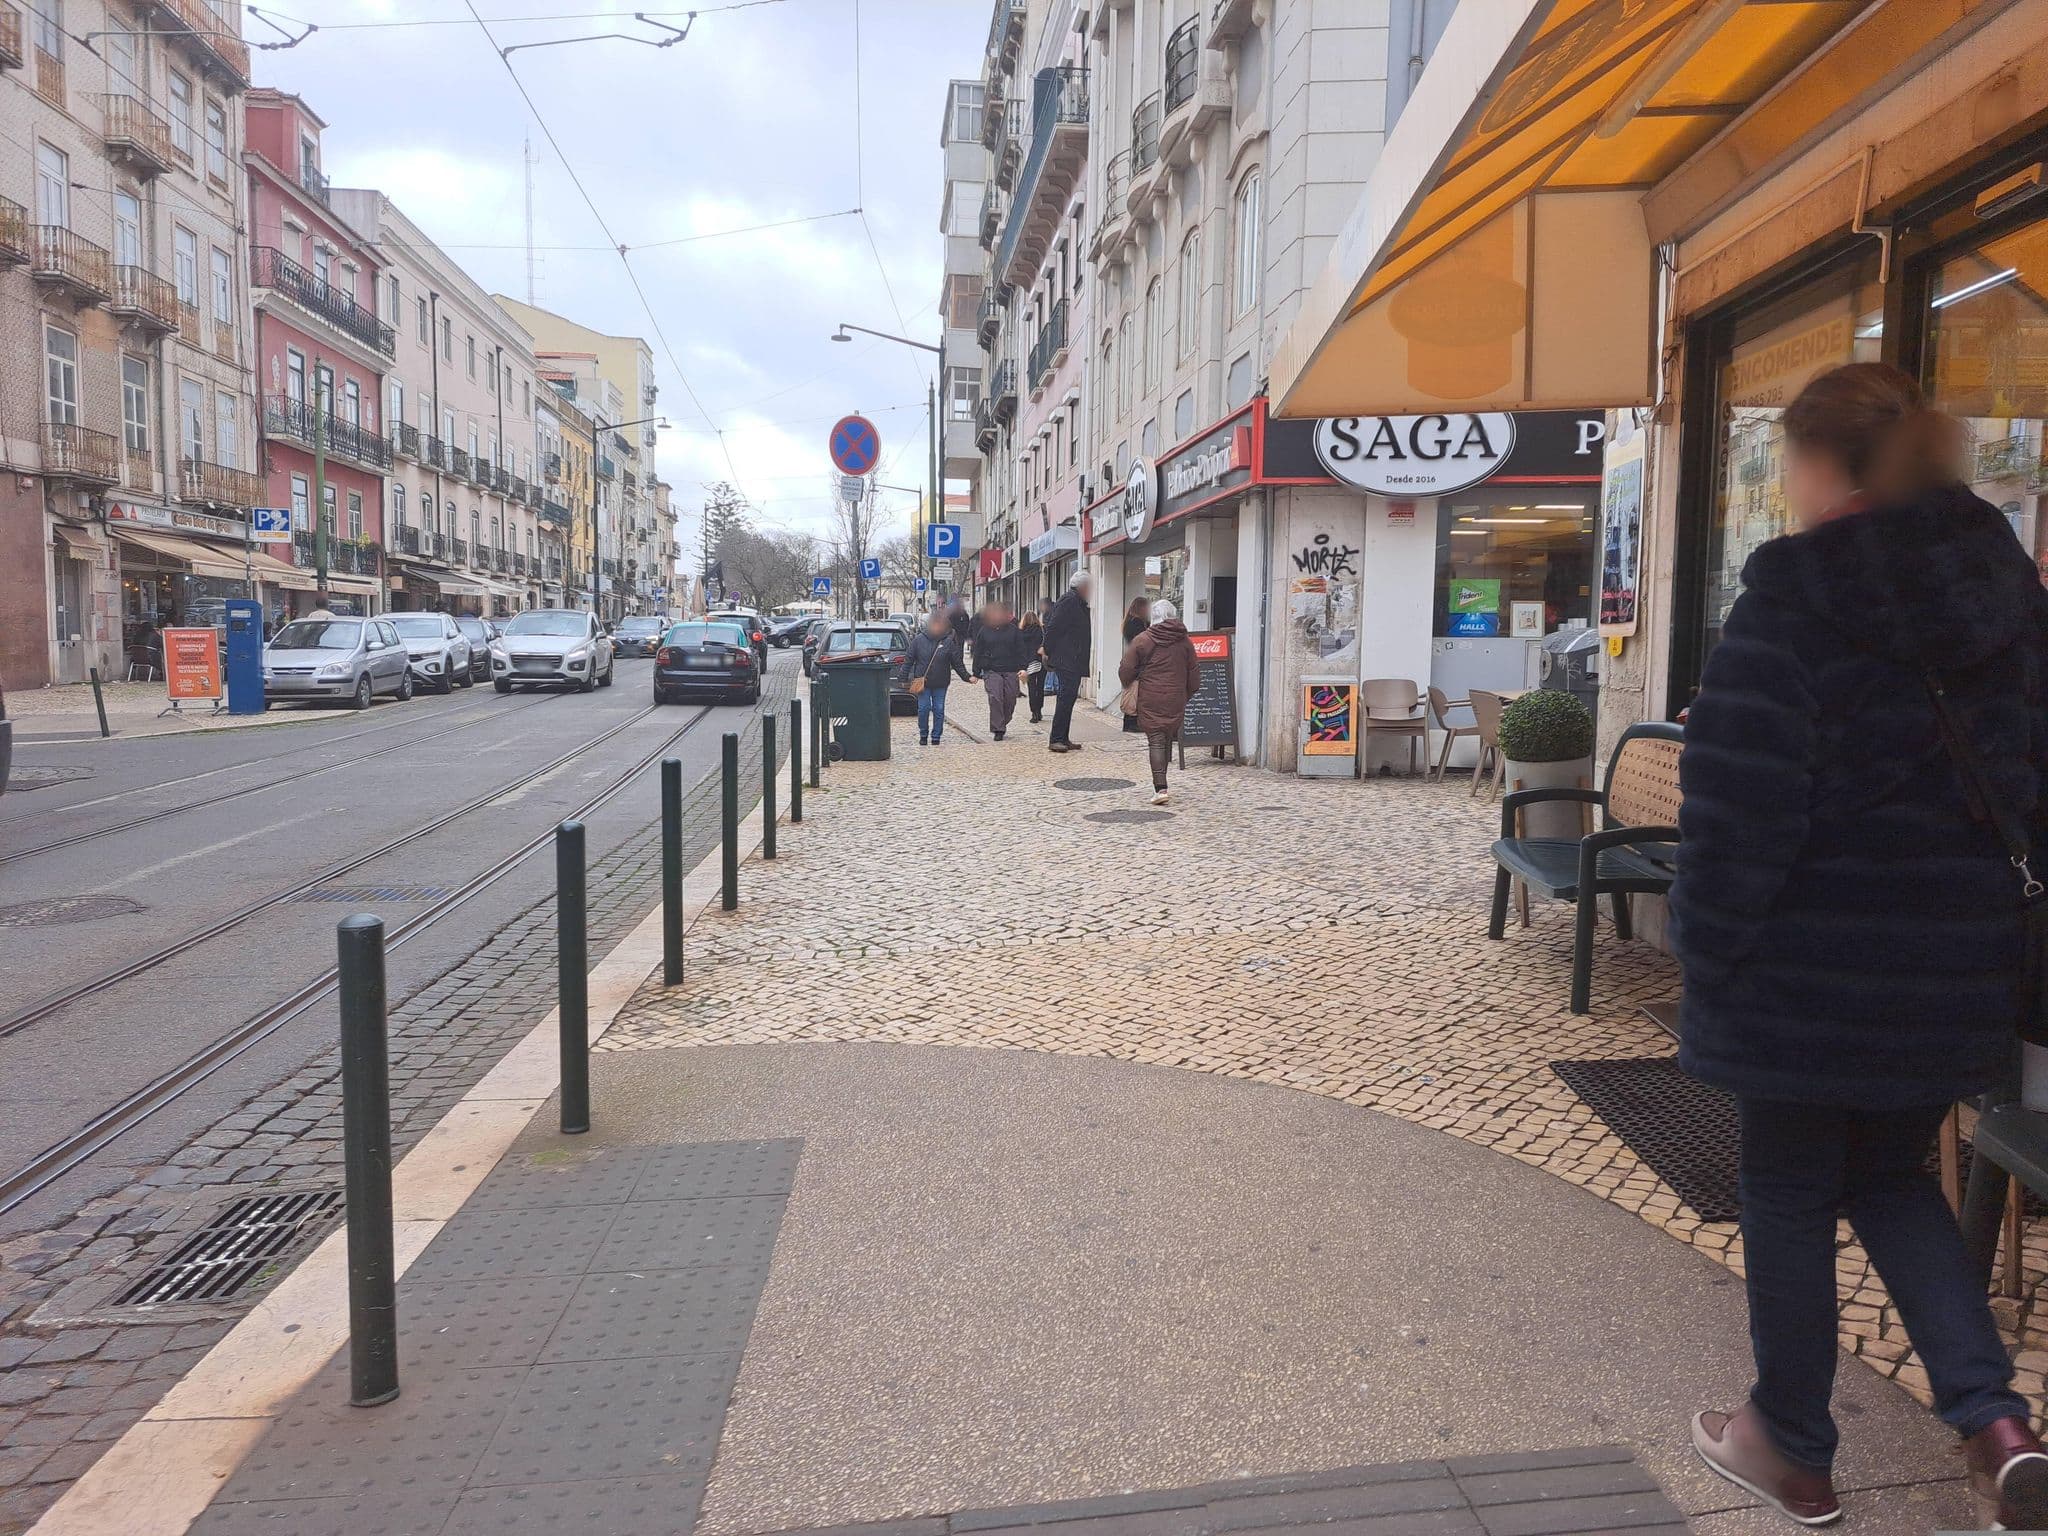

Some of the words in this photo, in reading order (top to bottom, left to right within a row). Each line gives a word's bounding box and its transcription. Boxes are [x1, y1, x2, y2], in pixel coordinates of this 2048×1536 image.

[1731, 323, 1843, 391] ENCOMENDE
[1329, 415, 1499, 461] SAGA
[1385, 475, 1413, 484] Desde
[1415, 475, 1436, 484] 2016
[1124, 480, 1147, 519] SAGA
[257, 510, 271, 528] P
[934, 527, 954, 555] P
[863, 560, 876, 577] P
[915, 581, 924, 590] P
[1457, 590, 1484, 600] Trident
[1459, 623, 1486, 631] HALLS
